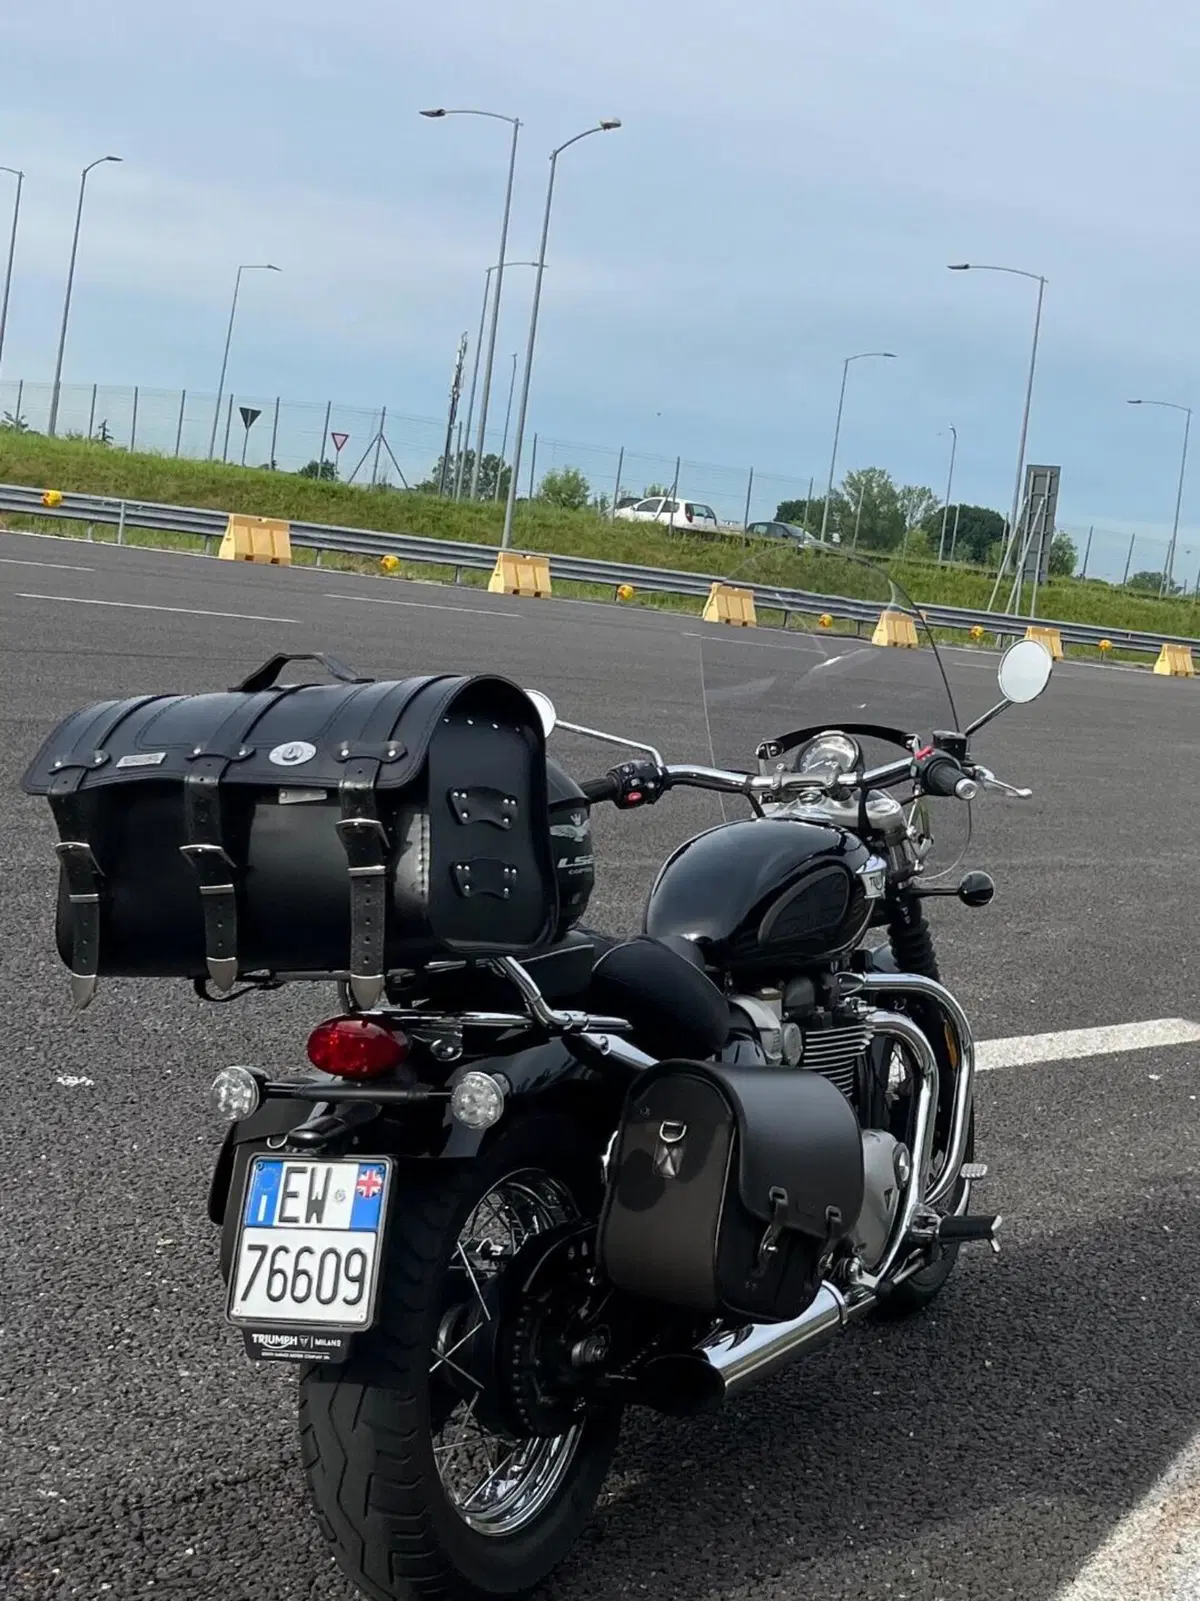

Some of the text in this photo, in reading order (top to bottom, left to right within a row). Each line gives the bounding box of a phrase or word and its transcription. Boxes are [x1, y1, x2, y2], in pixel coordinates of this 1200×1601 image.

[278, 1166, 333, 1224] EW
[240, 1243, 368, 1305] 76609
[251, 1333, 298, 1348] TRIUMPH
